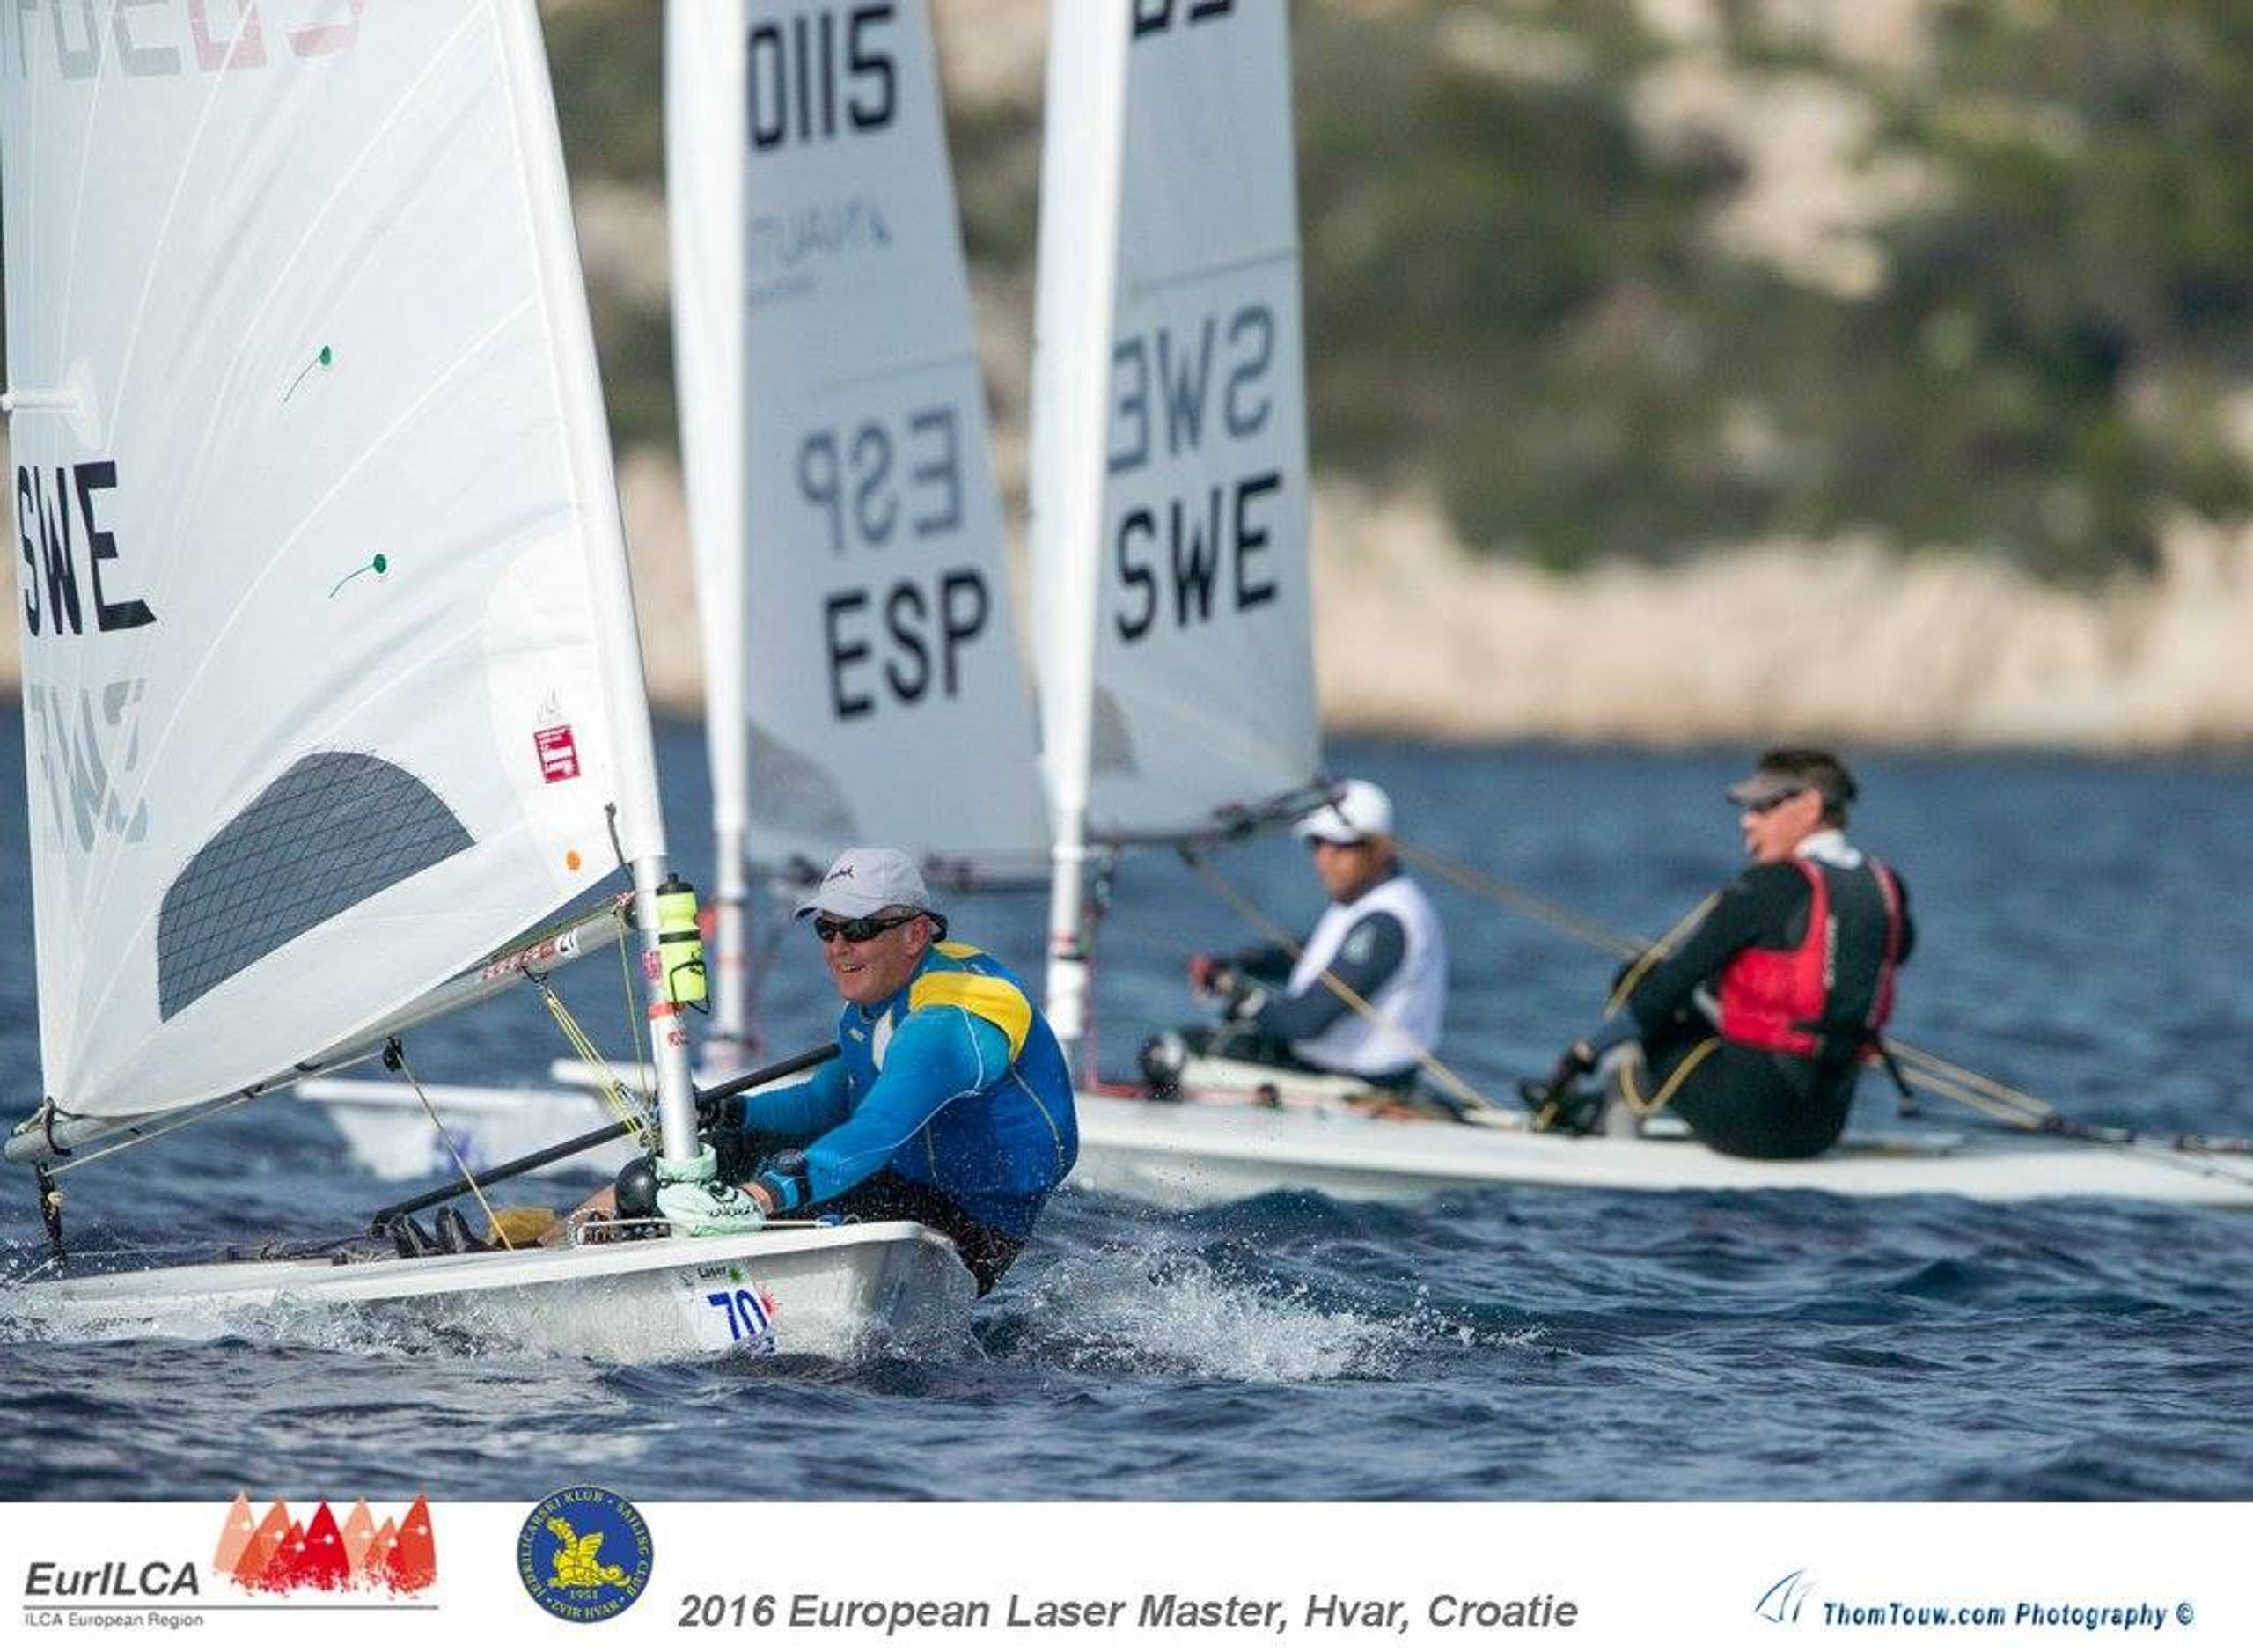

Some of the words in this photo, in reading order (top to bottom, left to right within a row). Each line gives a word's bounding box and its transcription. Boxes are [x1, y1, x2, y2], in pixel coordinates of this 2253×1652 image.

[747, 4, 896, 150] 0115
[18, 461, 157, 637] SWE
[1117, 466, 1283, 644] SWE
[824, 568, 990, 720] ESP
[707, 1290, 767, 1341] 70
